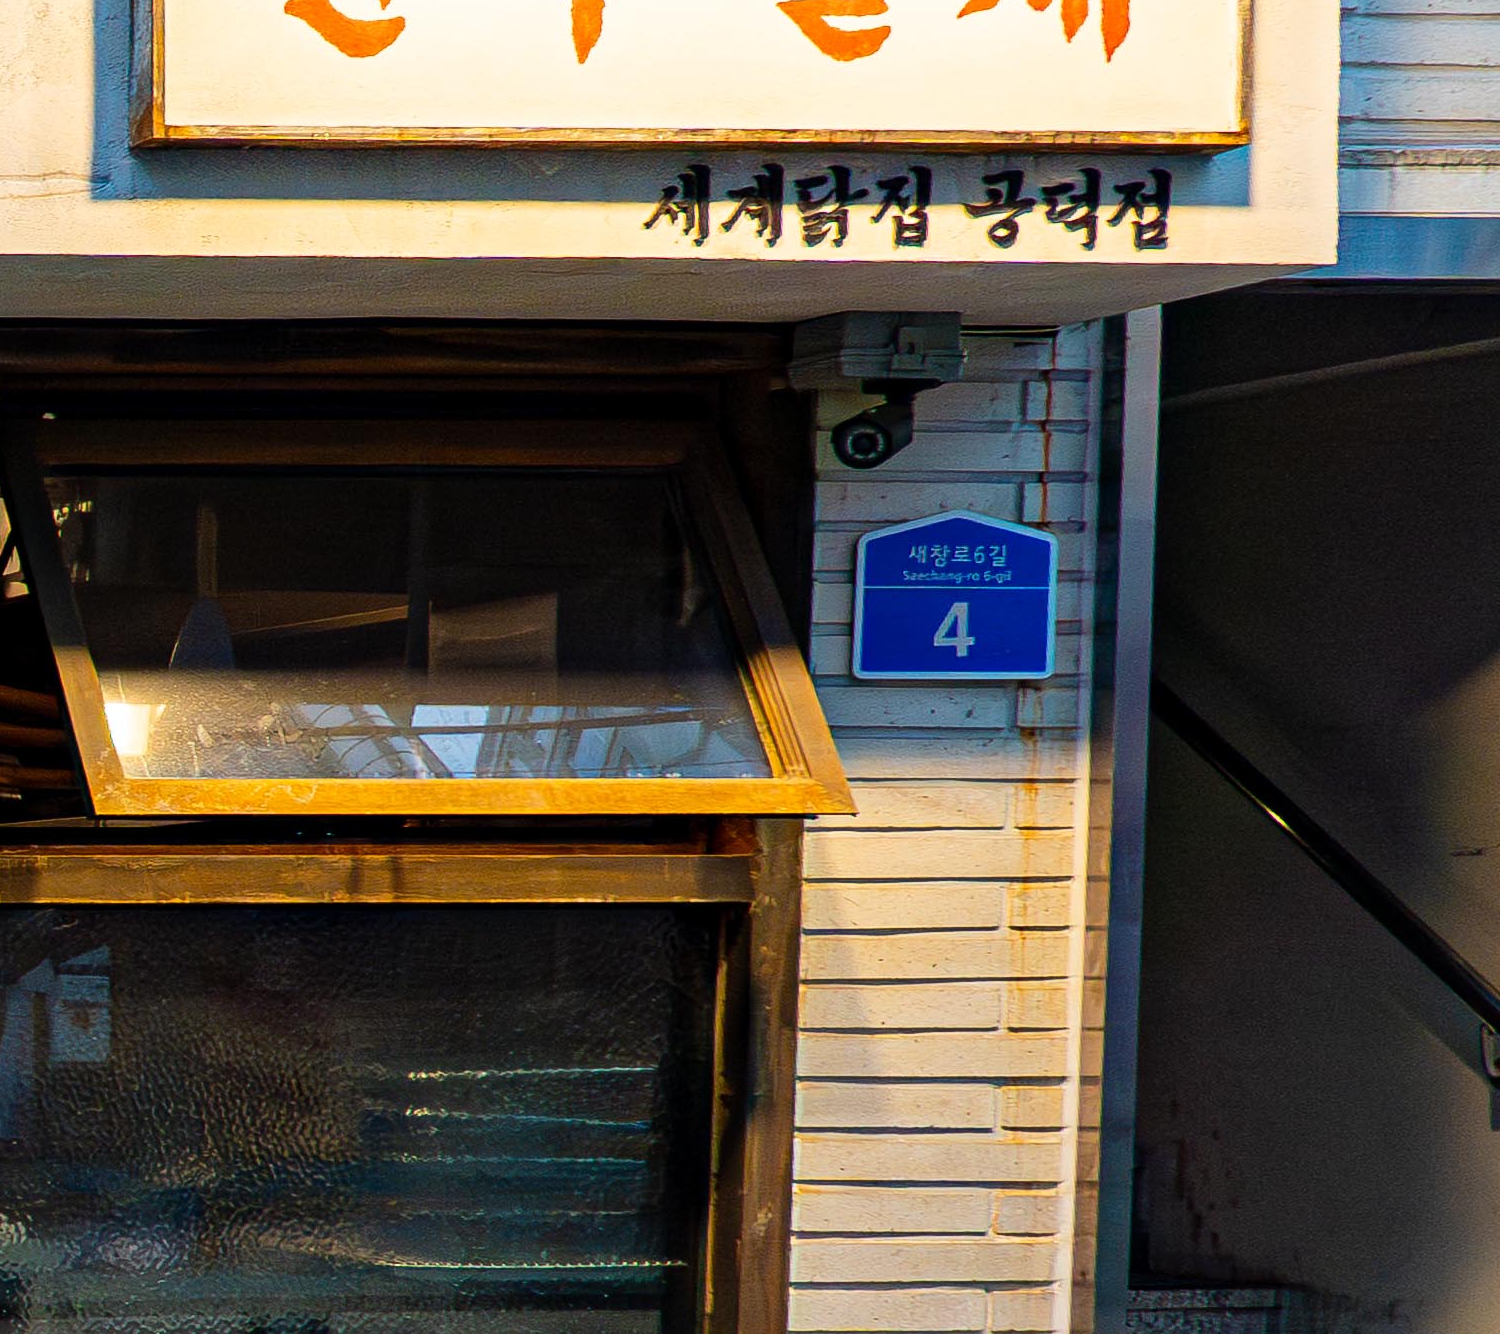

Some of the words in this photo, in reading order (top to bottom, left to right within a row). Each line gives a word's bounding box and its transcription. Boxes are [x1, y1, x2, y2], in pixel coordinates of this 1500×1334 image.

[643, 165, 935, 248] 세계닭집
[961, 169, 1175, 250] 공덕점
[909, 545, 1007, 567] 새창로6길
[903, 570, 980, 583] Saechang-ro
[983, 570, 1012, 583] 6-gil
[933, 602, 975, 657] 4
